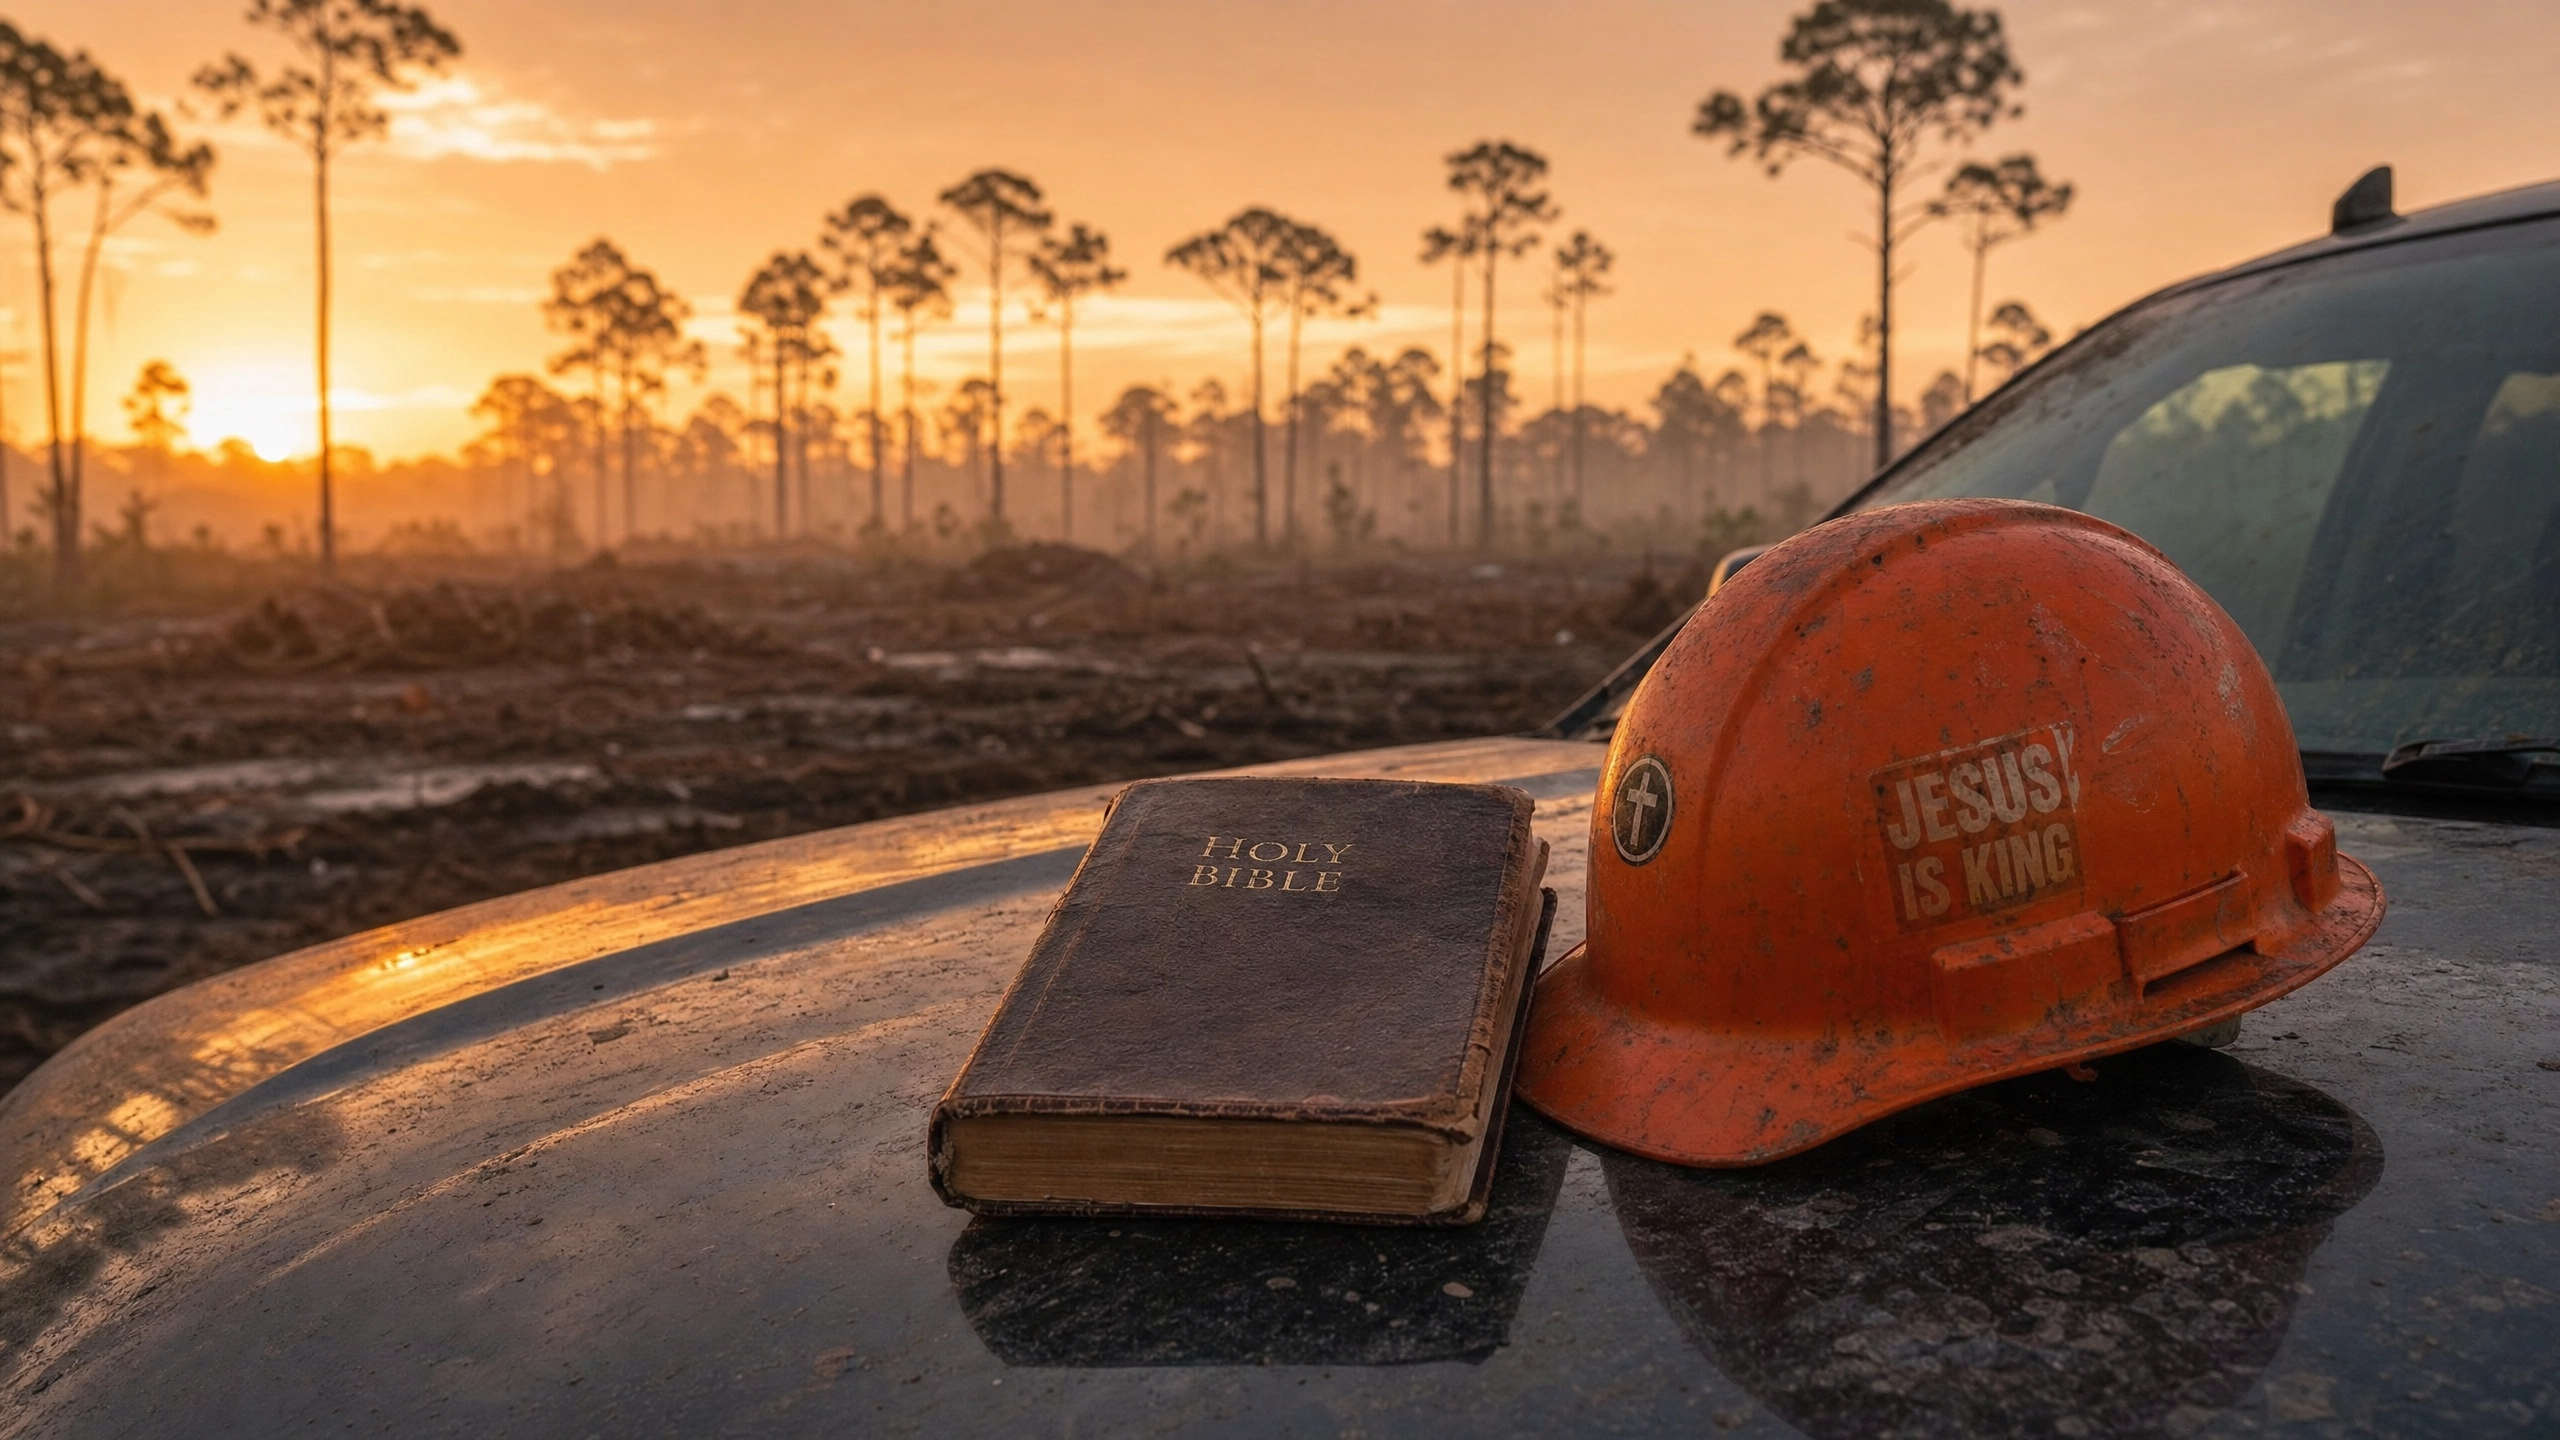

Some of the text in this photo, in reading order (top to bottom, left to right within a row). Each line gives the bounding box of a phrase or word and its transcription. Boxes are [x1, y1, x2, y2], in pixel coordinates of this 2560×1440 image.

[1886, 743, 2062, 850] JESUS
[1188, 864, 1342, 892] BIBLE
[1198, 836, 1355, 864] HOLY
[1897, 822, 2076, 921] IS KING
